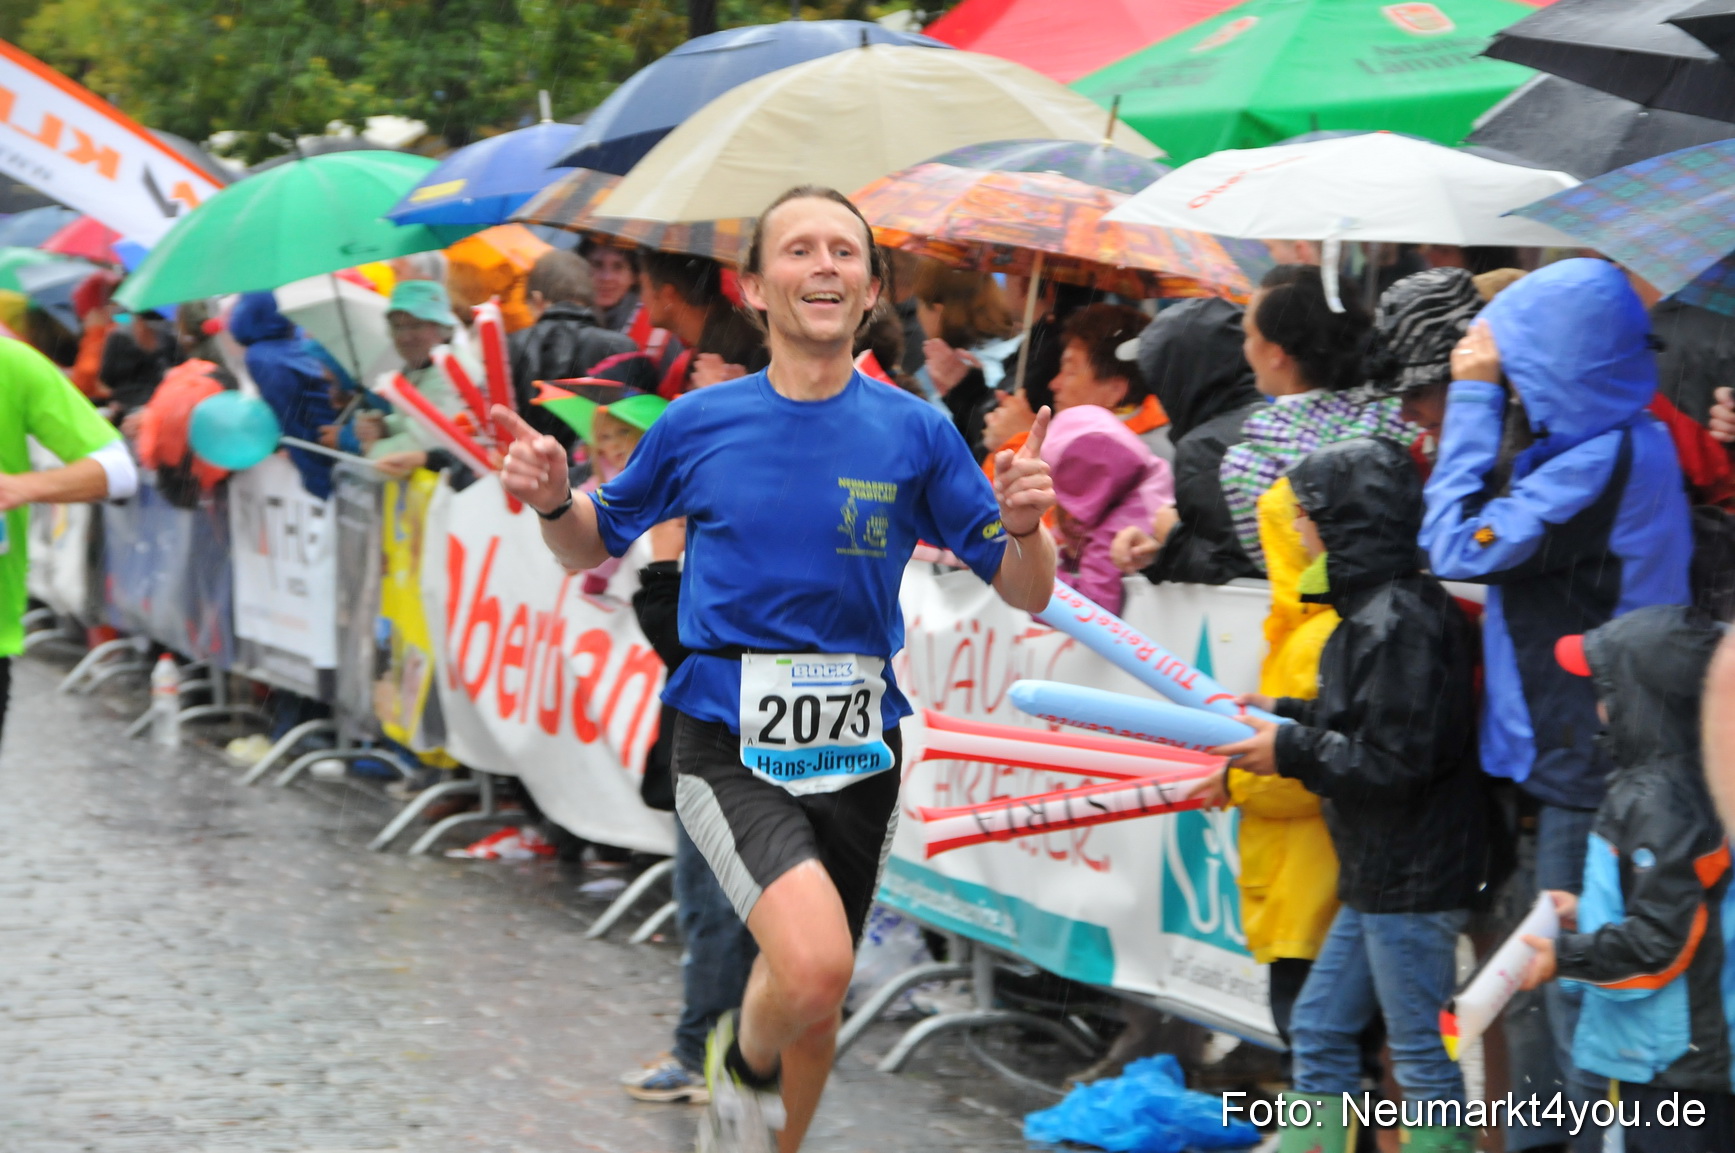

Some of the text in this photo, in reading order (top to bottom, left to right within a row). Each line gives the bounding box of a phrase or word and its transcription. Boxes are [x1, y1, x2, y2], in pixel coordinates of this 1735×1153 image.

[792, 663, 853, 679] BOCK
[1153, 655, 1200, 691] TUI
[758, 689, 871, 745] 2073
[757, 751, 880, 777] Hans-Jürgen
